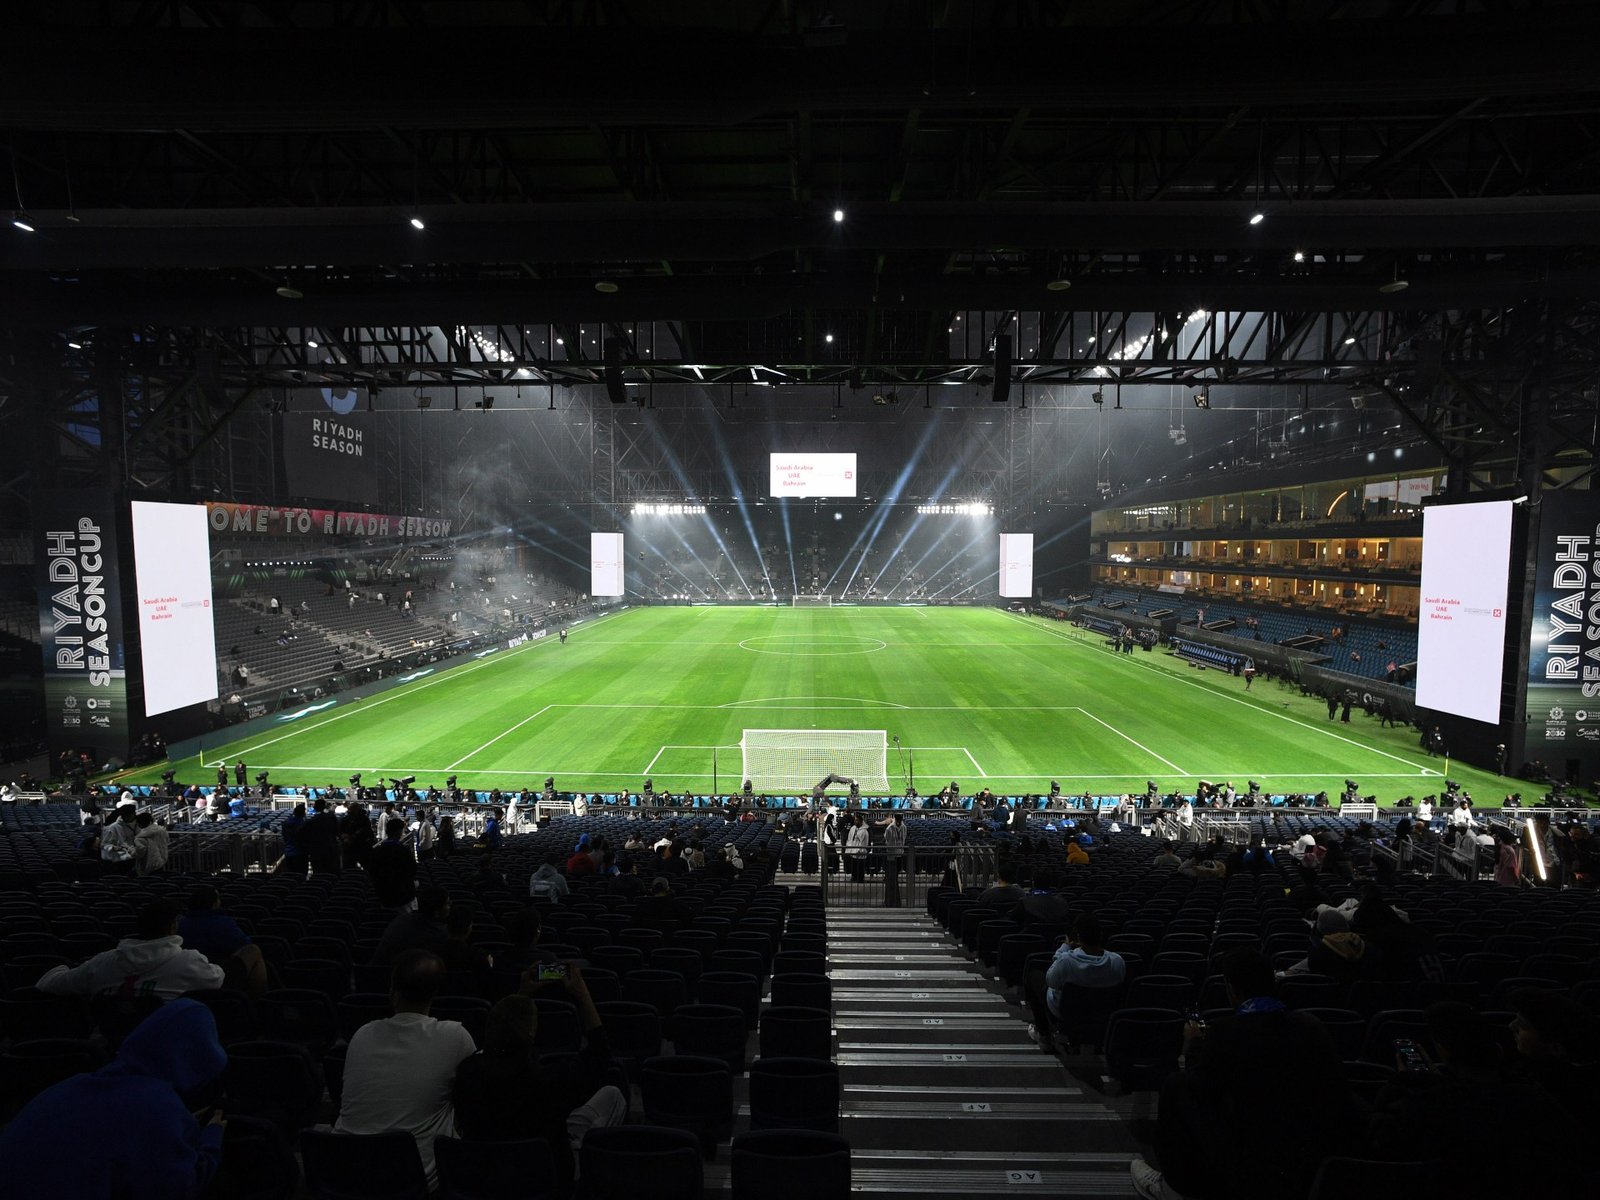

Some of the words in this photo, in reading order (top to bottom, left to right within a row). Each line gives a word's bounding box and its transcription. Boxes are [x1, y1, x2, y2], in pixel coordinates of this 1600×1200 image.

[313, 418, 362, 442] RIYADH
[313, 434, 362, 456] SEASON
[284, 511, 312, 533] TO
[323, 514, 389, 536] RIYADH
[398, 518, 451, 537] SEASON
[47, 531, 85, 669] RIYADH
[1546, 535, 1590, 679] RIYADH
